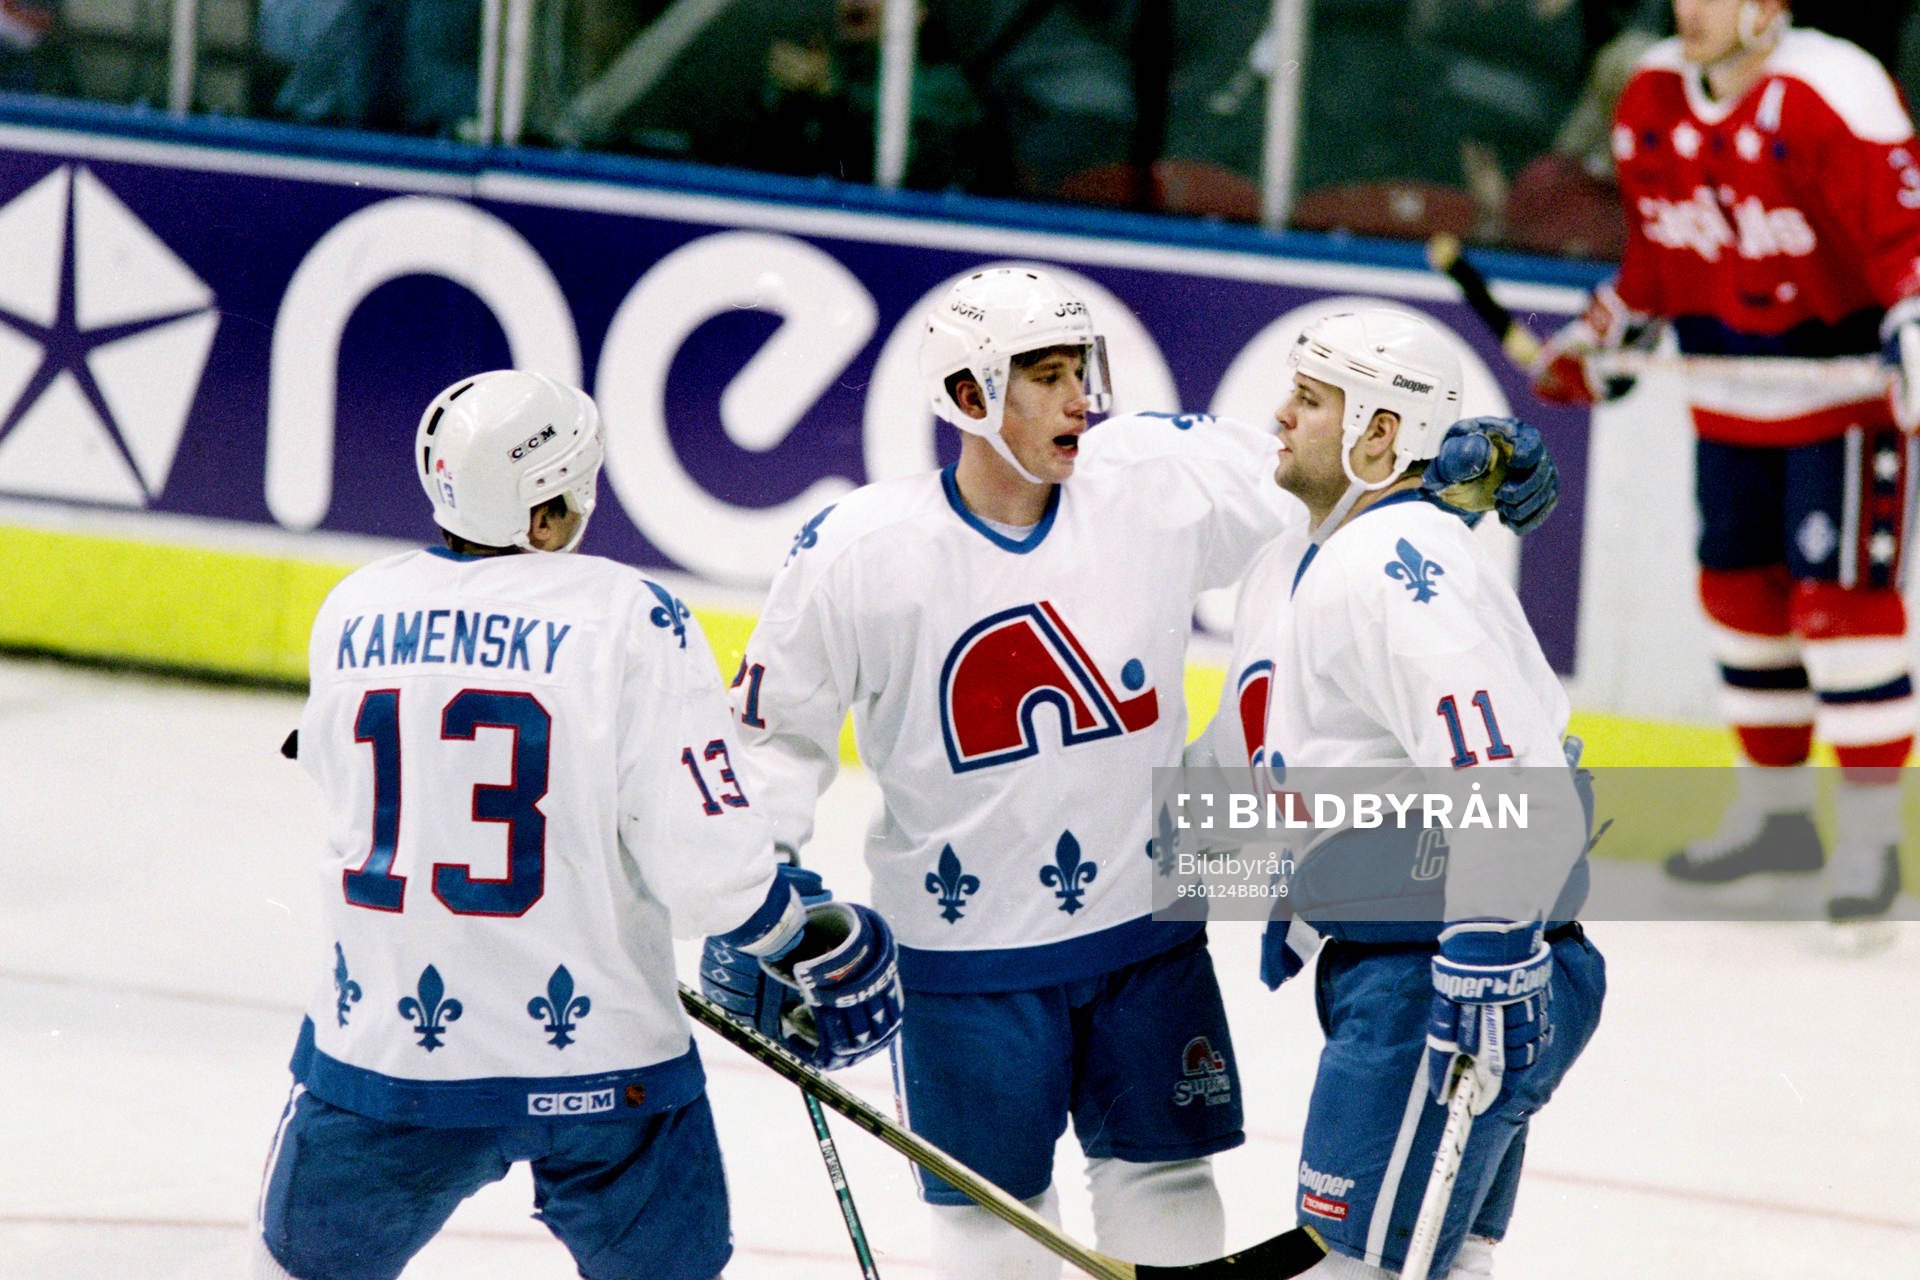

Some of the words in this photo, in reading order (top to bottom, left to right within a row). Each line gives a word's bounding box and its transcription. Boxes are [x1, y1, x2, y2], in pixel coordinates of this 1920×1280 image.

[1391, 373, 1434, 395] Cooper
[510, 424, 557, 461] CCM
[337, 609, 572, 674] KAMENSKY
[1436, 690, 1514, 771] 11
[341, 687, 552, 918] 13
[681, 738, 750, 816] 13
[530, 1091, 613, 1114] CCM
